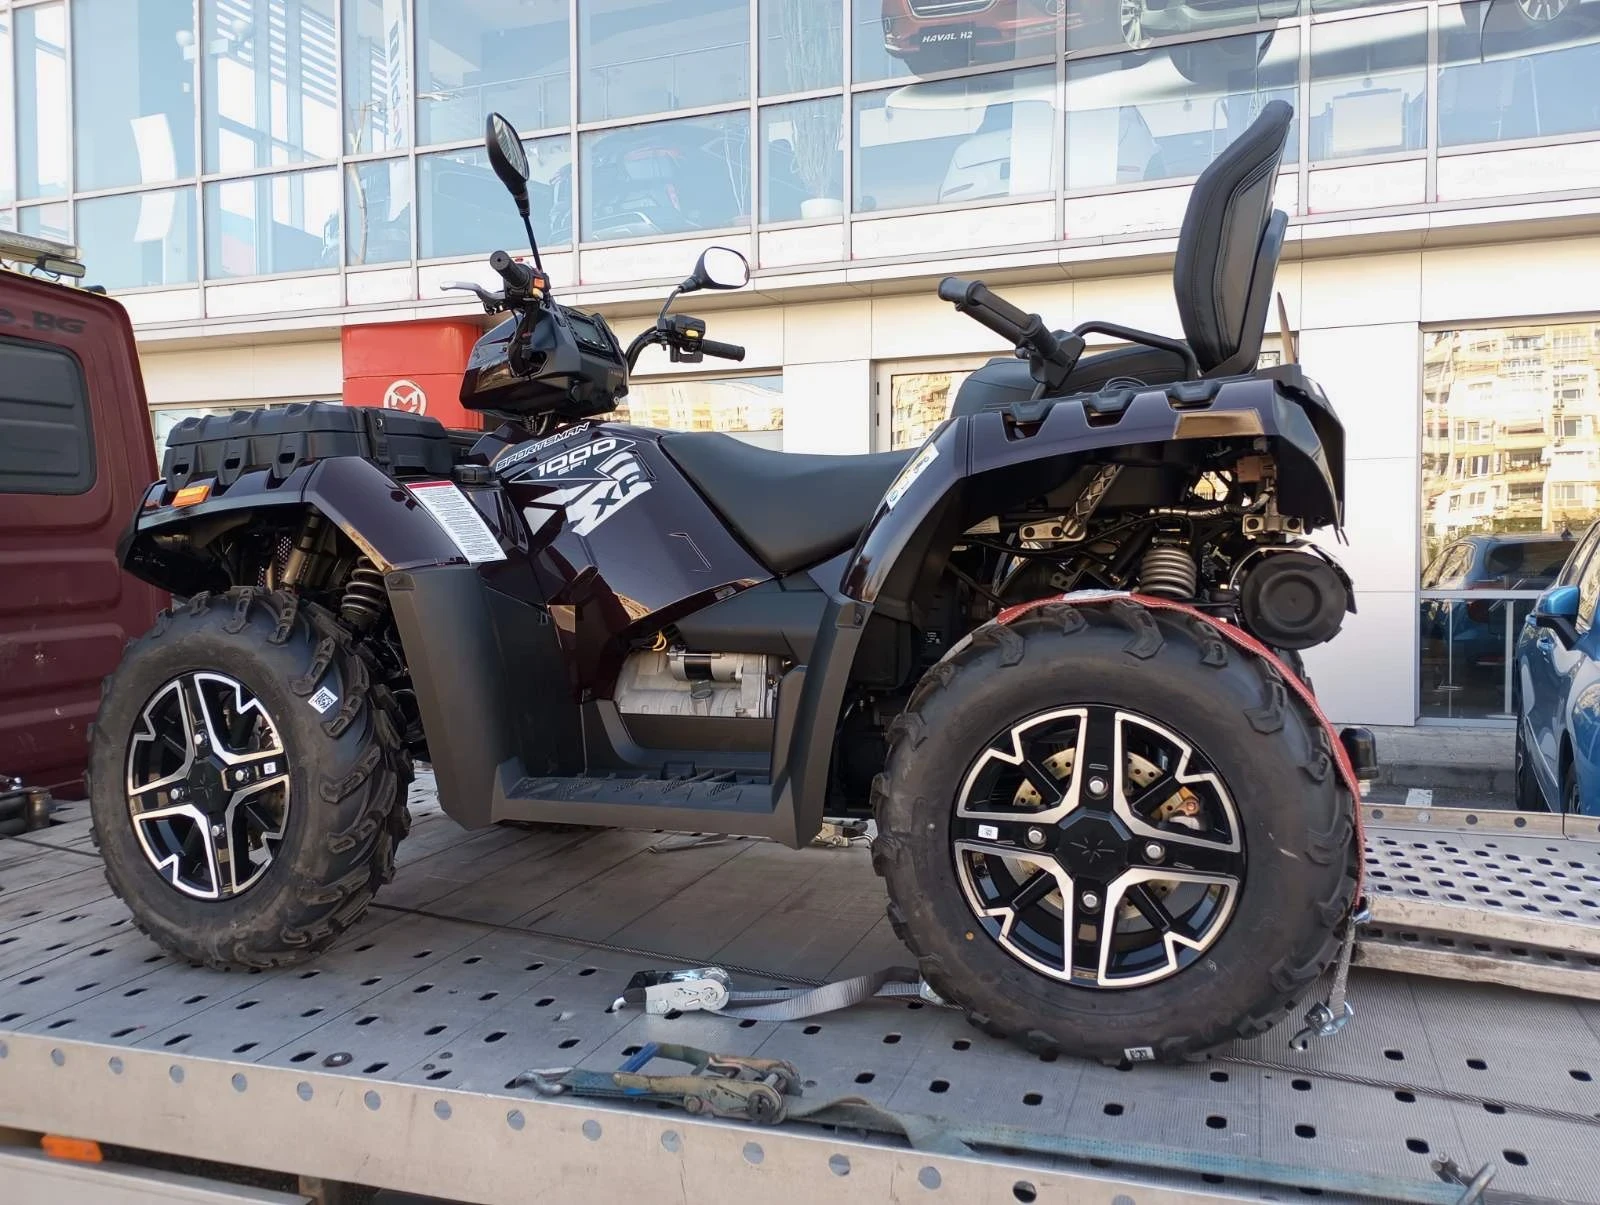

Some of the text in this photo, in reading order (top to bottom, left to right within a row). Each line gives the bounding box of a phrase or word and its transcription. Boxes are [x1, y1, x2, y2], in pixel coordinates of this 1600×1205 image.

[922, 33, 956, 42] HAVAL
[495, 421, 590, 472] SPORTSMAN
[537, 439, 617, 477] 1000
[557, 459, 587, 476] EFI
